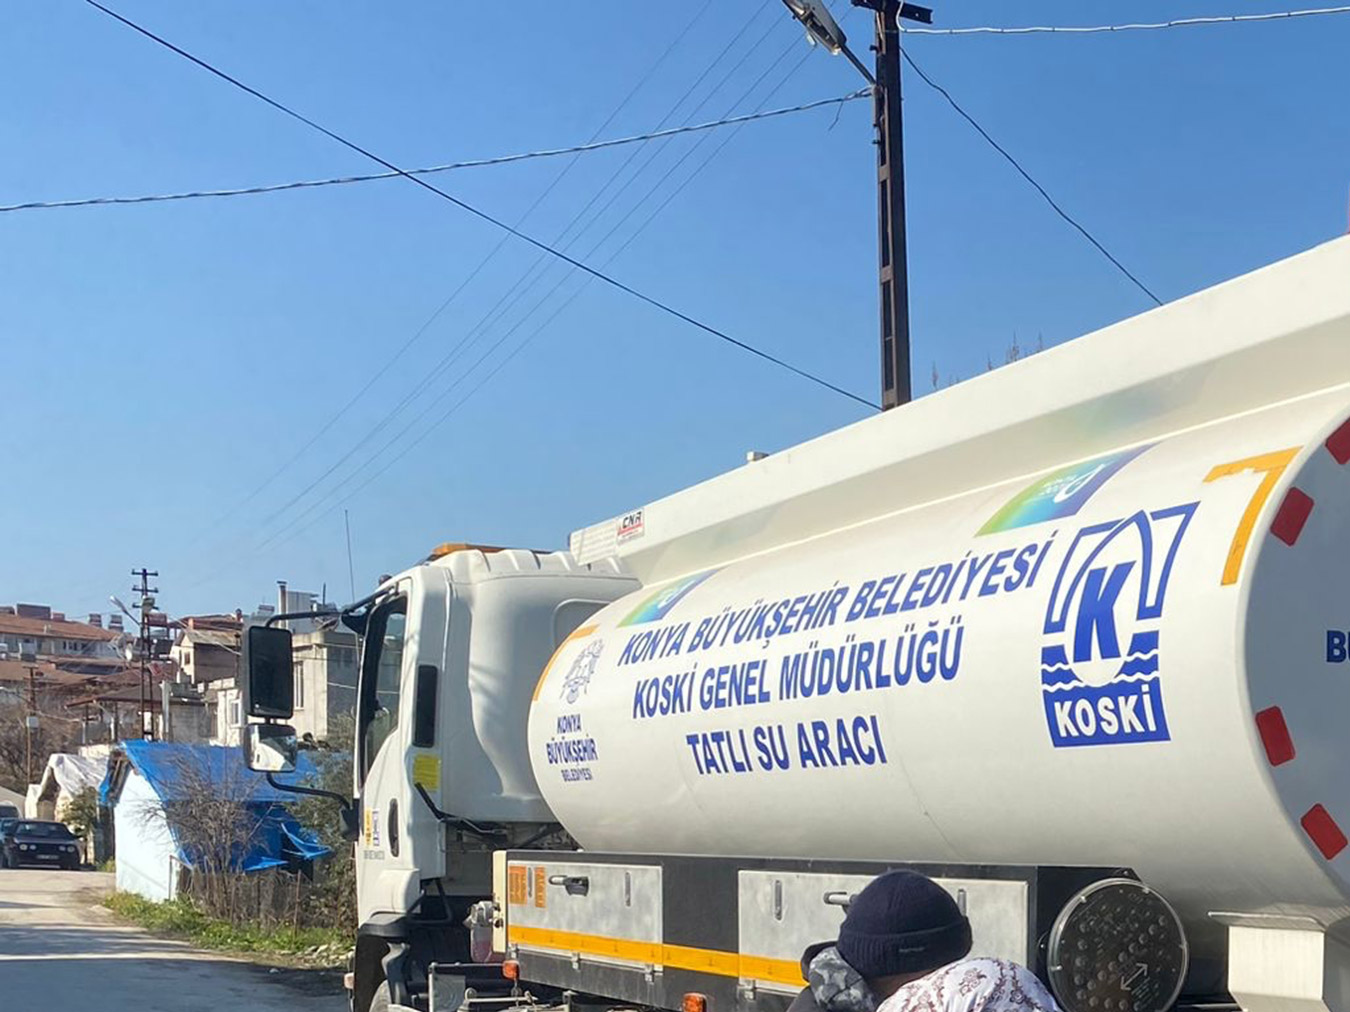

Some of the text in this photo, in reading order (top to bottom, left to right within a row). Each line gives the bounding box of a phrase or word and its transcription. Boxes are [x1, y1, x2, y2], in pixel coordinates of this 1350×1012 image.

[617, 529, 1060, 667] KONYA BÜYÜKŞEHİR BELEDİYESİ
[633, 614, 965, 719] KOSKİ GENEL MÜDÜRLÜĞÜ
[557, 713, 582, 734] KONYA
[1053, 684, 1158, 738] KOSKİ
[686, 714, 888, 775] TATLI SU ARACI
